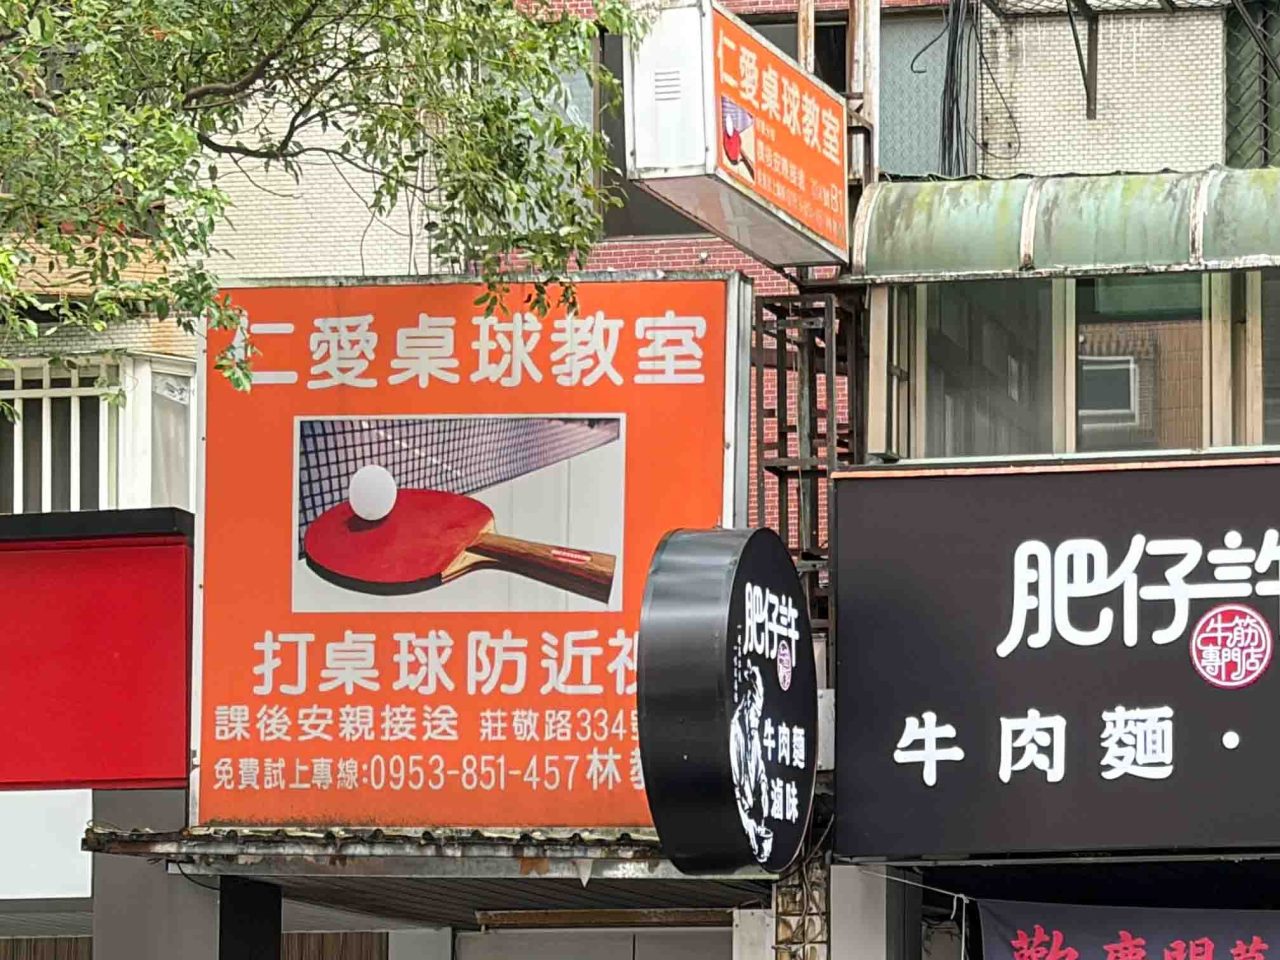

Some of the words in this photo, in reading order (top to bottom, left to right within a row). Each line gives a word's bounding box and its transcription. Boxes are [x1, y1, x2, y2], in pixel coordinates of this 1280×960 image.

[232, 310, 707, 390] 仁愛桌球教室
[743, 582, 800, 668] 肥仔許
[214, 704, 459, 742] 課後安親接送
[479, 709, 641, 742] 莊敬路334
[763, 718, 806, 769] 牛肉麵
